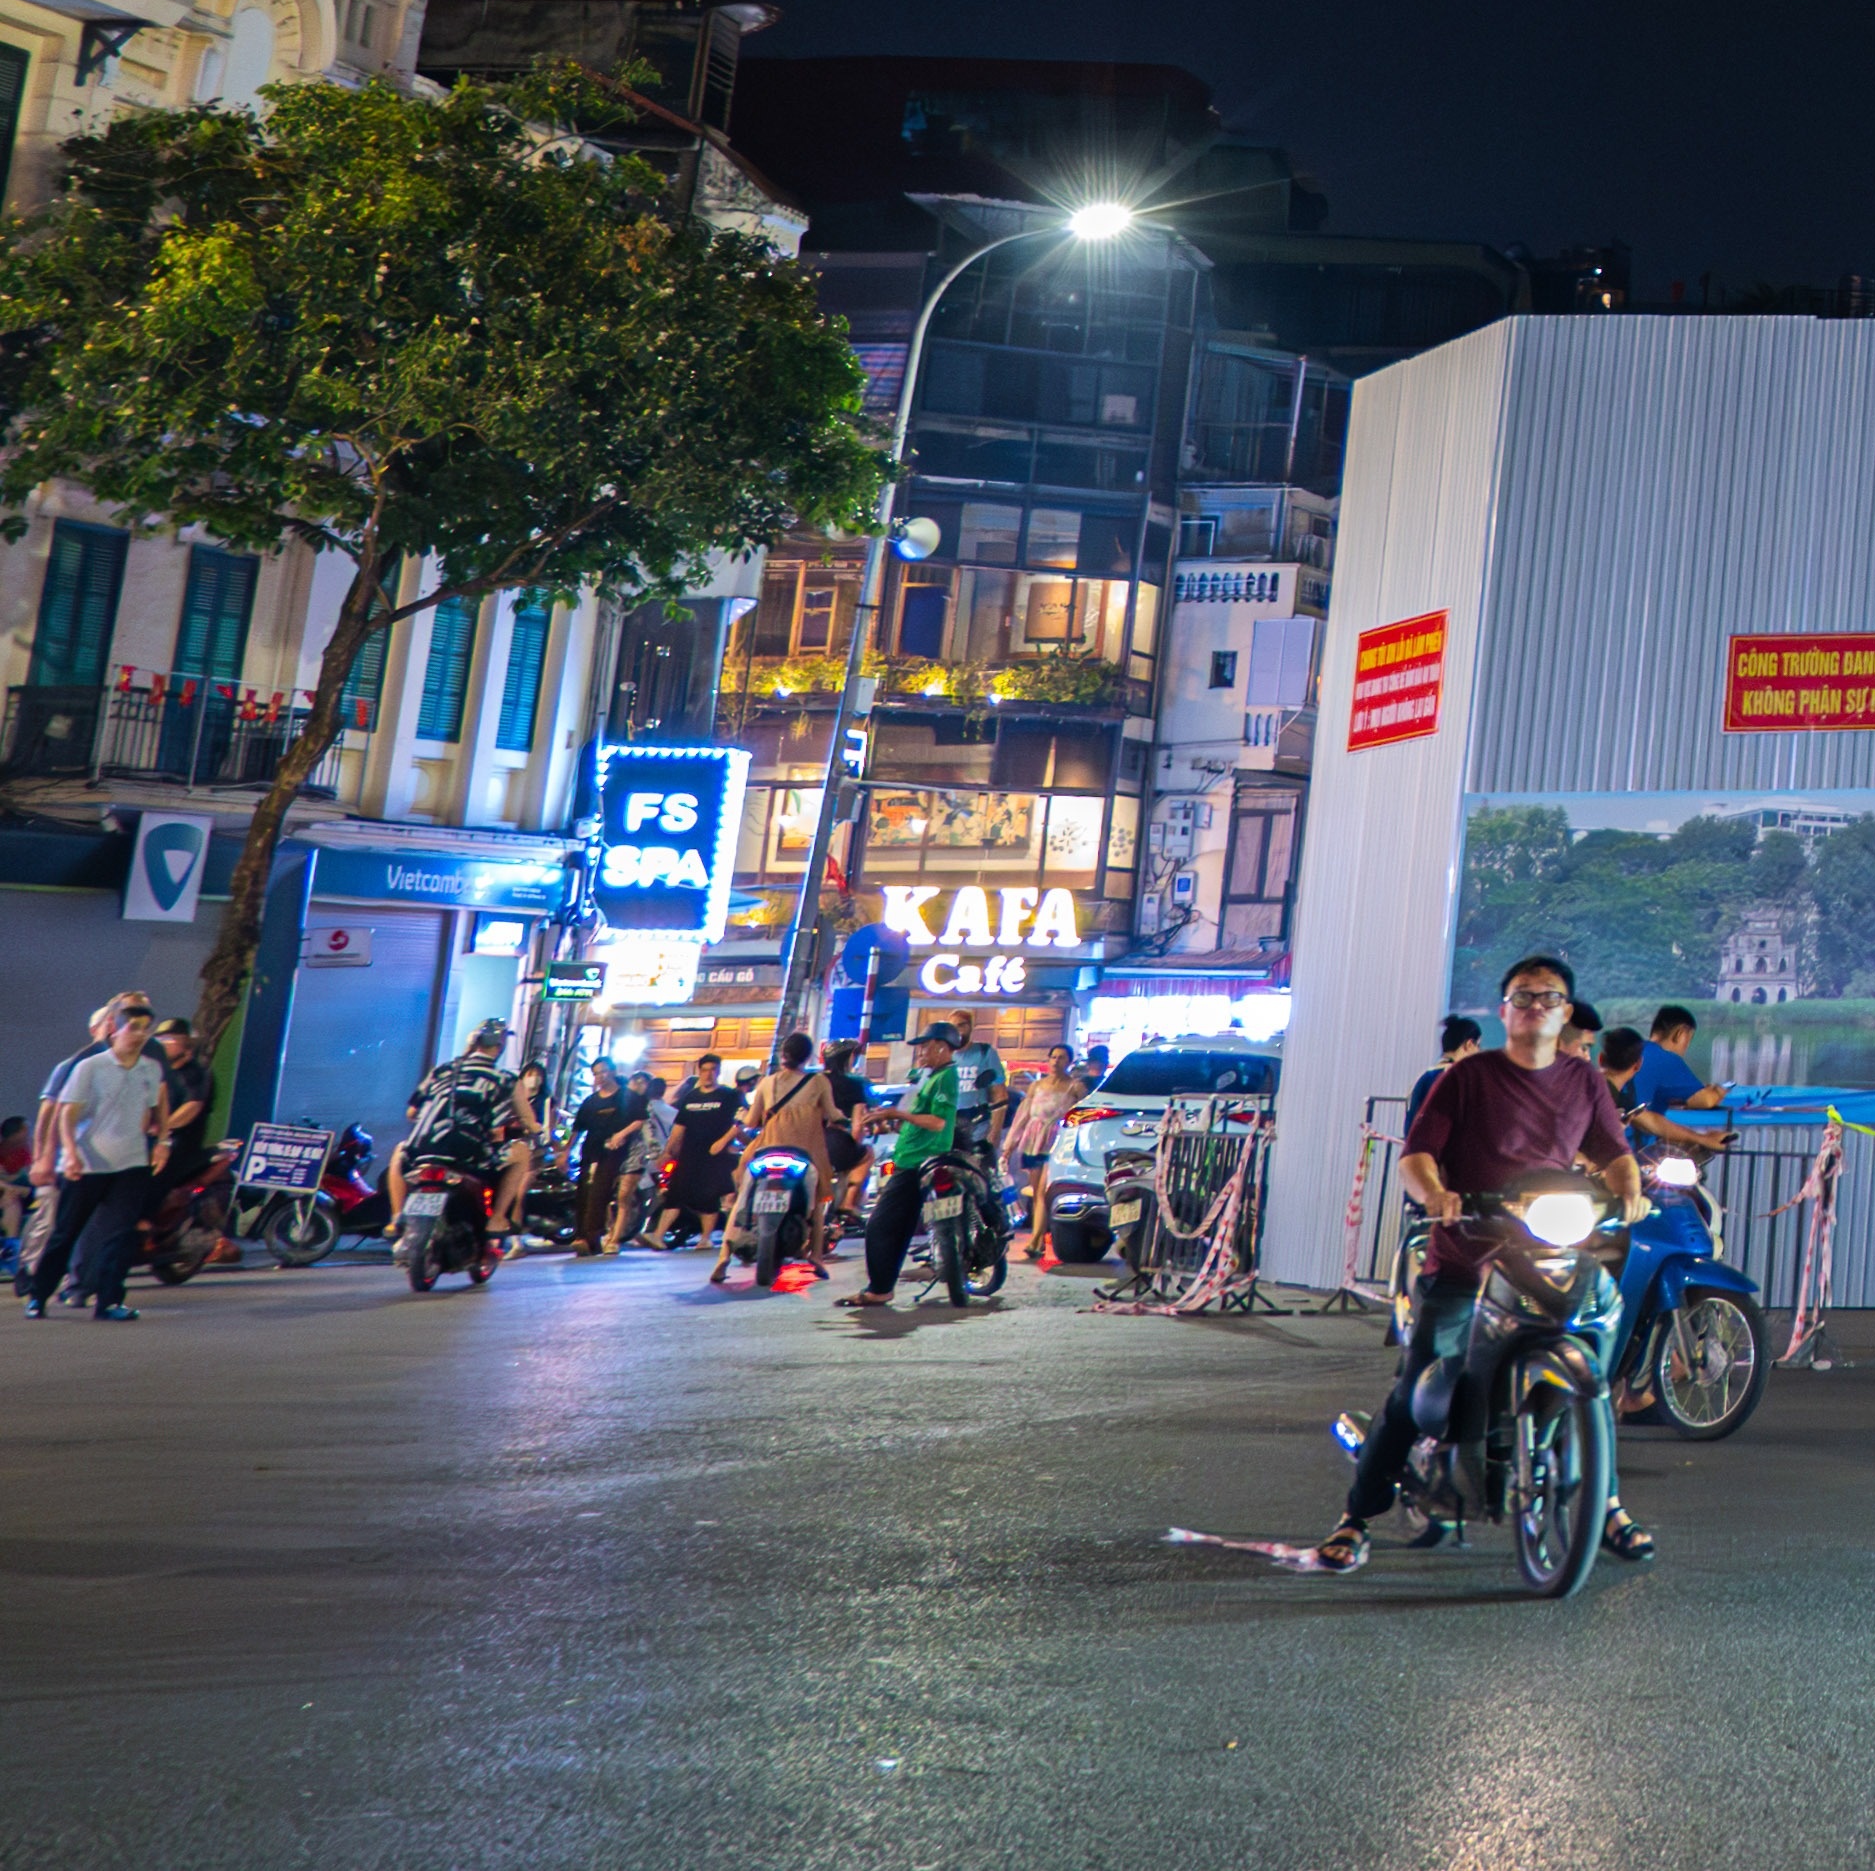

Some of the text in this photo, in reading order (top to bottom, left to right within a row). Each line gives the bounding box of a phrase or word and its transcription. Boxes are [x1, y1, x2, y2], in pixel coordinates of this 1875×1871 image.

[1737, 648, 1778, 678] CÔNG
[1782, 646, 1840, 677] TRƯỜNG
[1742, 685, 1796, 716] KHÔNG
[1799, 684, 1842, 720] PHẬN
[1845, 686, 1869, 719] SỰ
[626, 792, 698, 833] FS
[387, 864, 482, 897] Vietcomb
[602, 844, 710, 888] SPA
[882, 885, 1082, 947] KAFA
[920, 953, 1027, 994] Café
[244, 1155, 266, 1182] P
